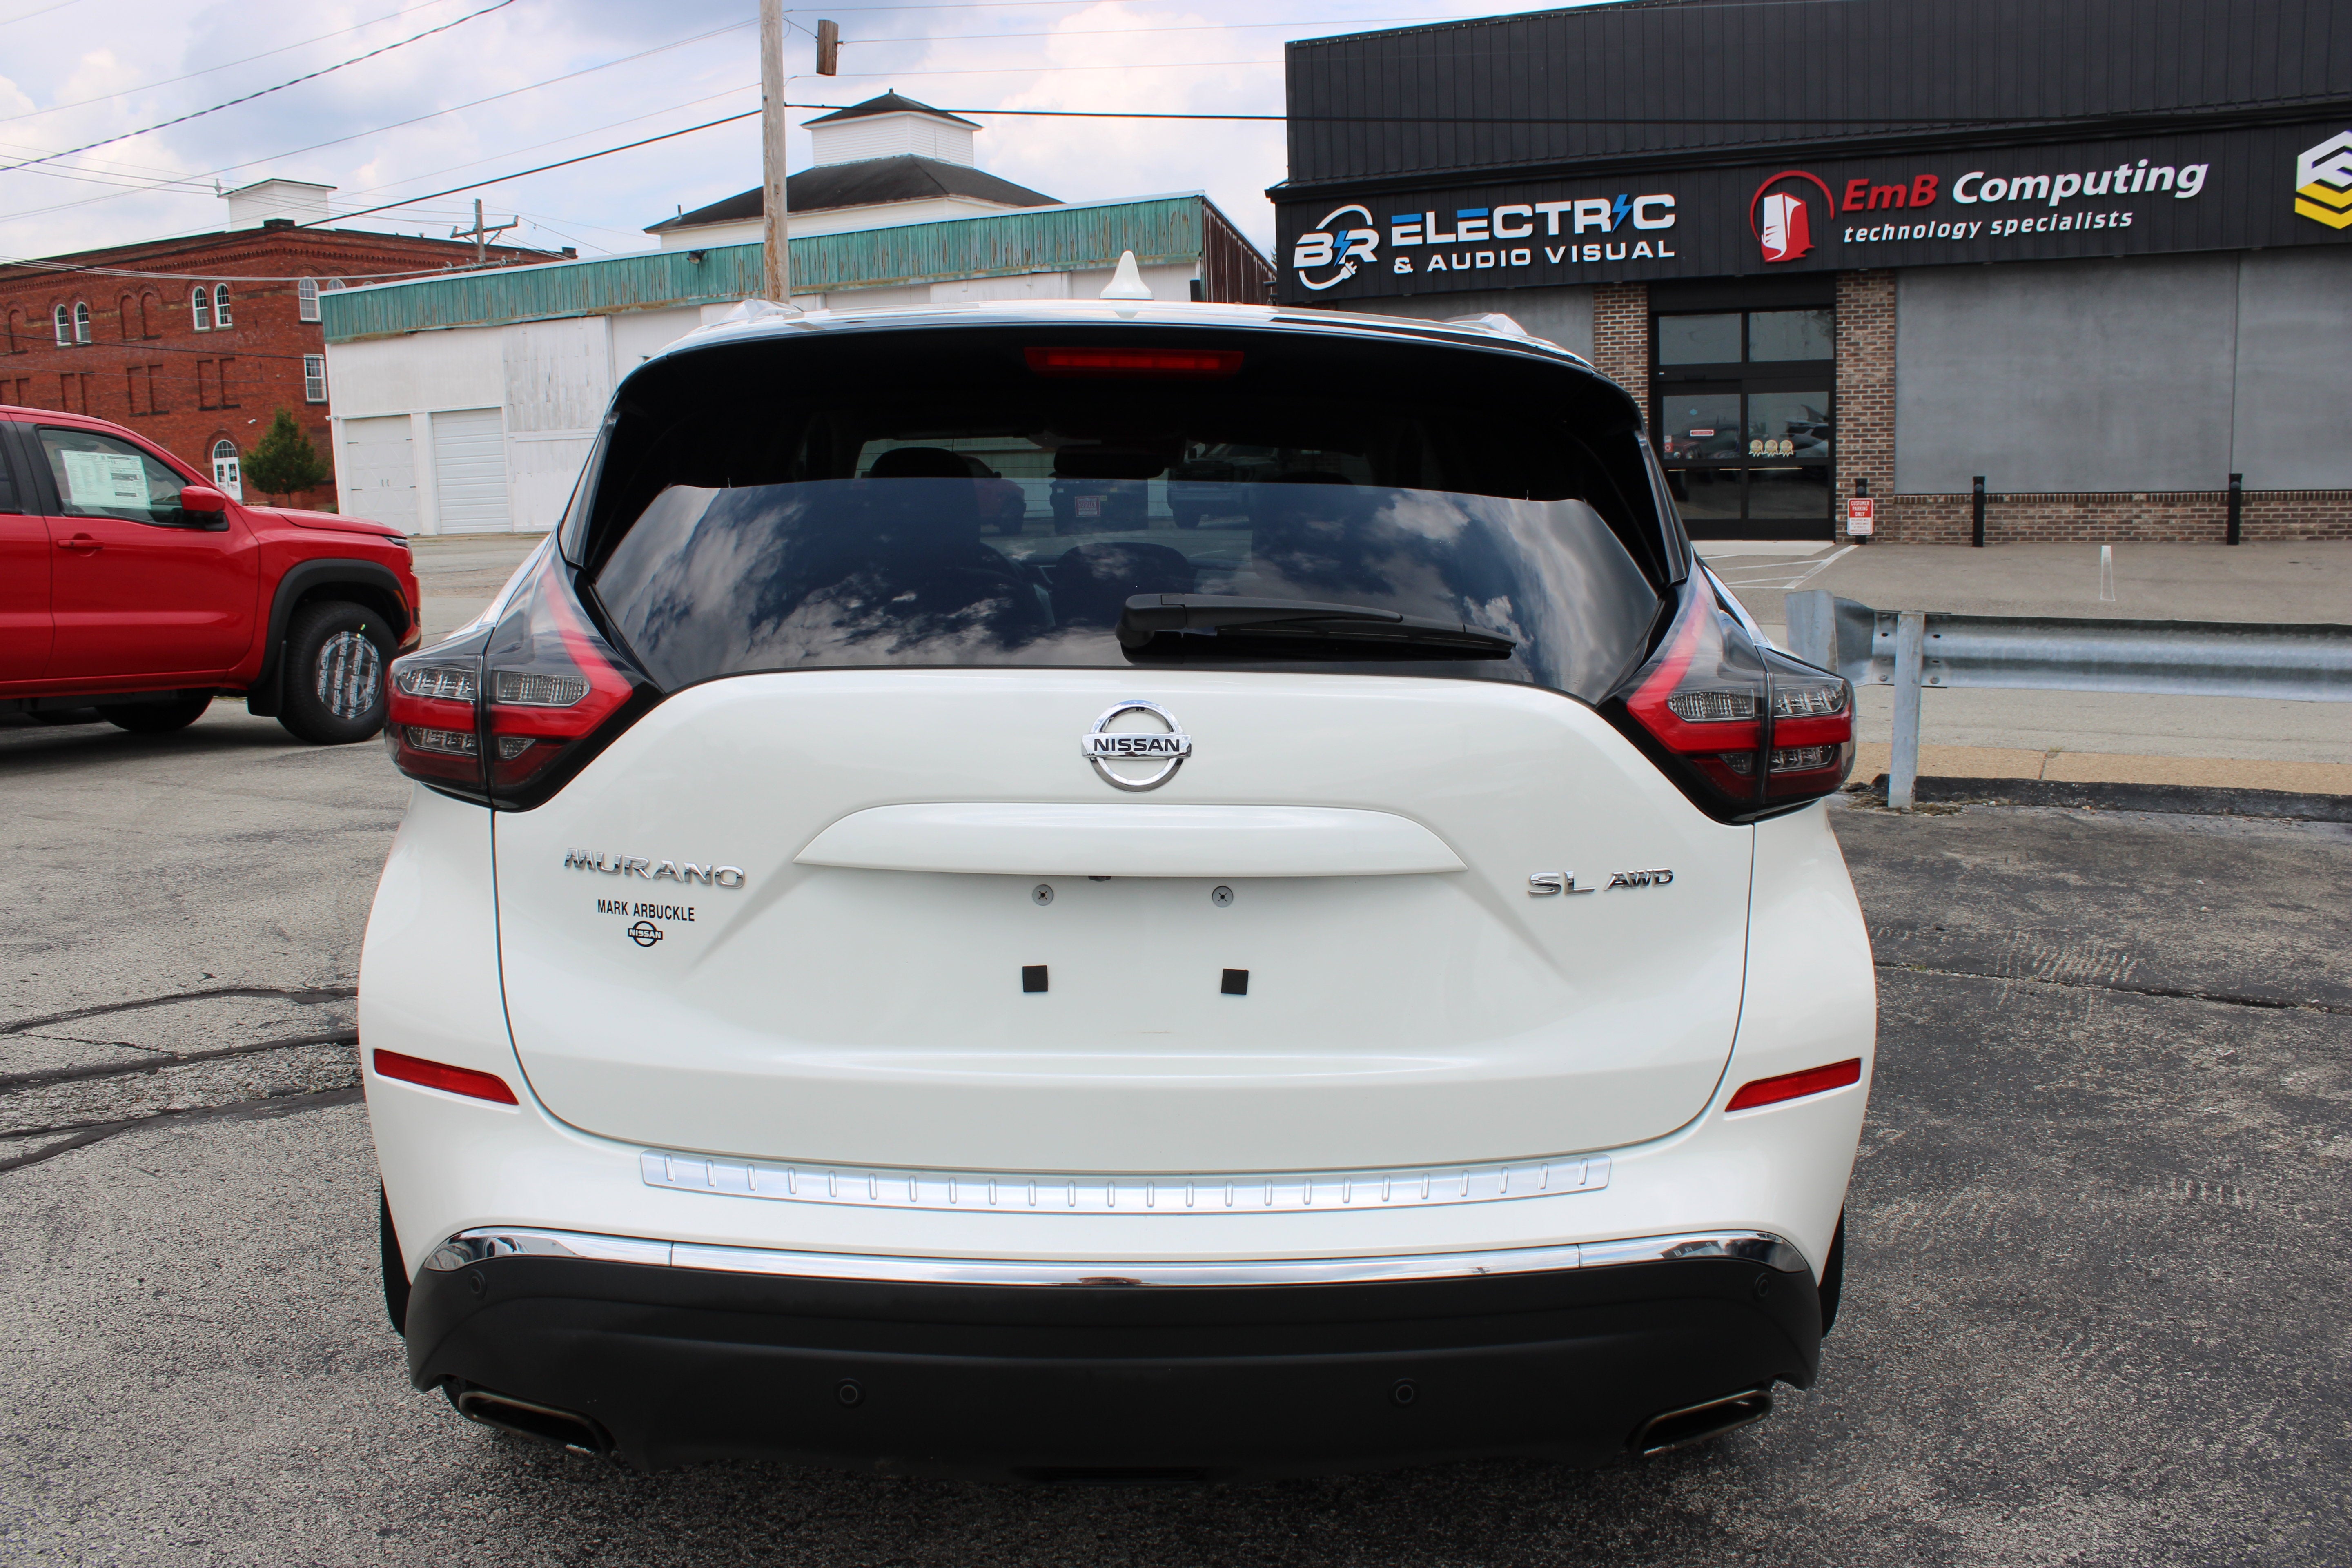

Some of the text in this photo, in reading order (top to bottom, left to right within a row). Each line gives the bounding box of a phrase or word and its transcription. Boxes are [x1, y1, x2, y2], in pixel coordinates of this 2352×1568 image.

[1842, 159, 2208, 211] EmB Computing
[1844, 210, 2134, 243] technology specialists
[1394, 241, 1675, 274] & AUDIO VISUAL
[1094, 739, 1180, 751] NISSAN
[564, 848, 745, 889] MURANO
[1528, 868, 1674, 897] SL AWD
[598, 899, 695, 922] MARK ARBUCKLE
[629, 929, 662, 939] NISSAN
